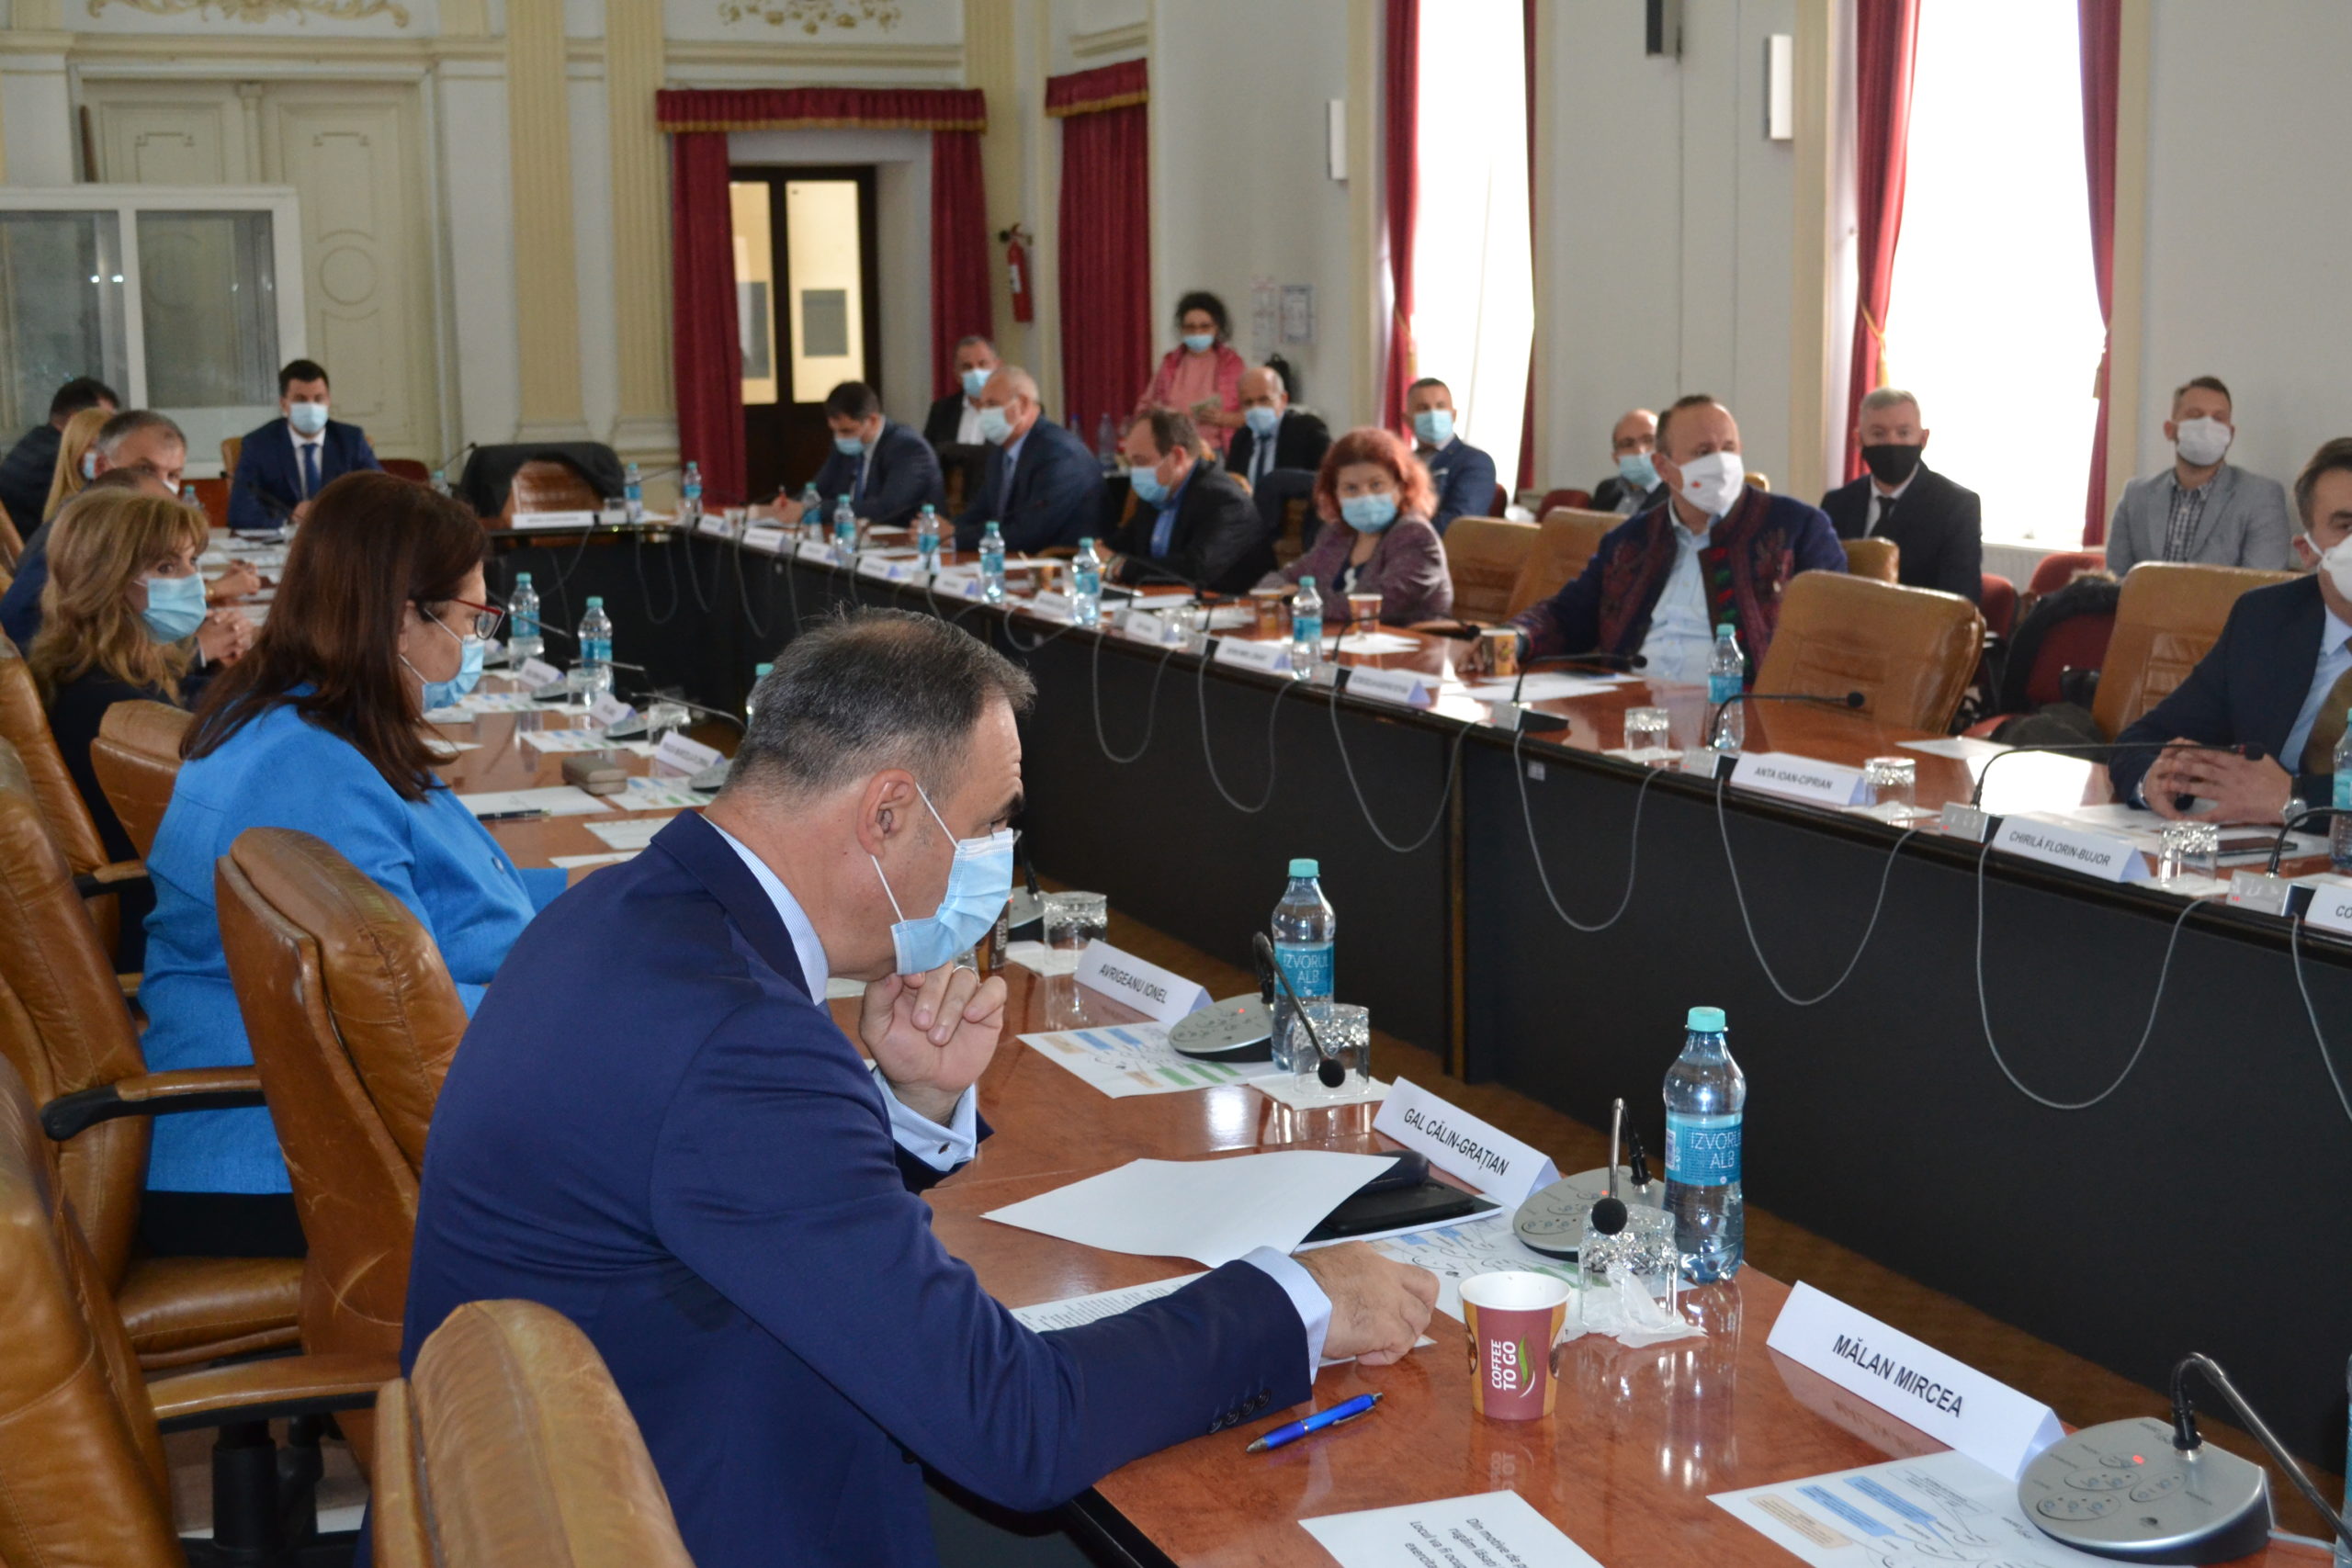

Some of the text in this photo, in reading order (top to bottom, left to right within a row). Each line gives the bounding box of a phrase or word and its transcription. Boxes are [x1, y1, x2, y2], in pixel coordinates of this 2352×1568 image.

[2044, 840, 2111, 866] FLORIN-BUJOR
[1099, 964, 1168, 1004] AVRIGEANU IONEL
[1296, 969, 1319, 984] ALB
[1404, 1108, 1510, 1176] GAL CĂLIN-GRAȚIAN
[1690, 1129, 1742, 1150] IZVORU
[1710, 1150, 1735, 1168] ALB
[1491, 1338, 1502, 1389] COFFEE
[1502, 1341, 1517, 1391] TO GO
[1832, 1334, 1963, 1418] MĂLAN MIRCEA
